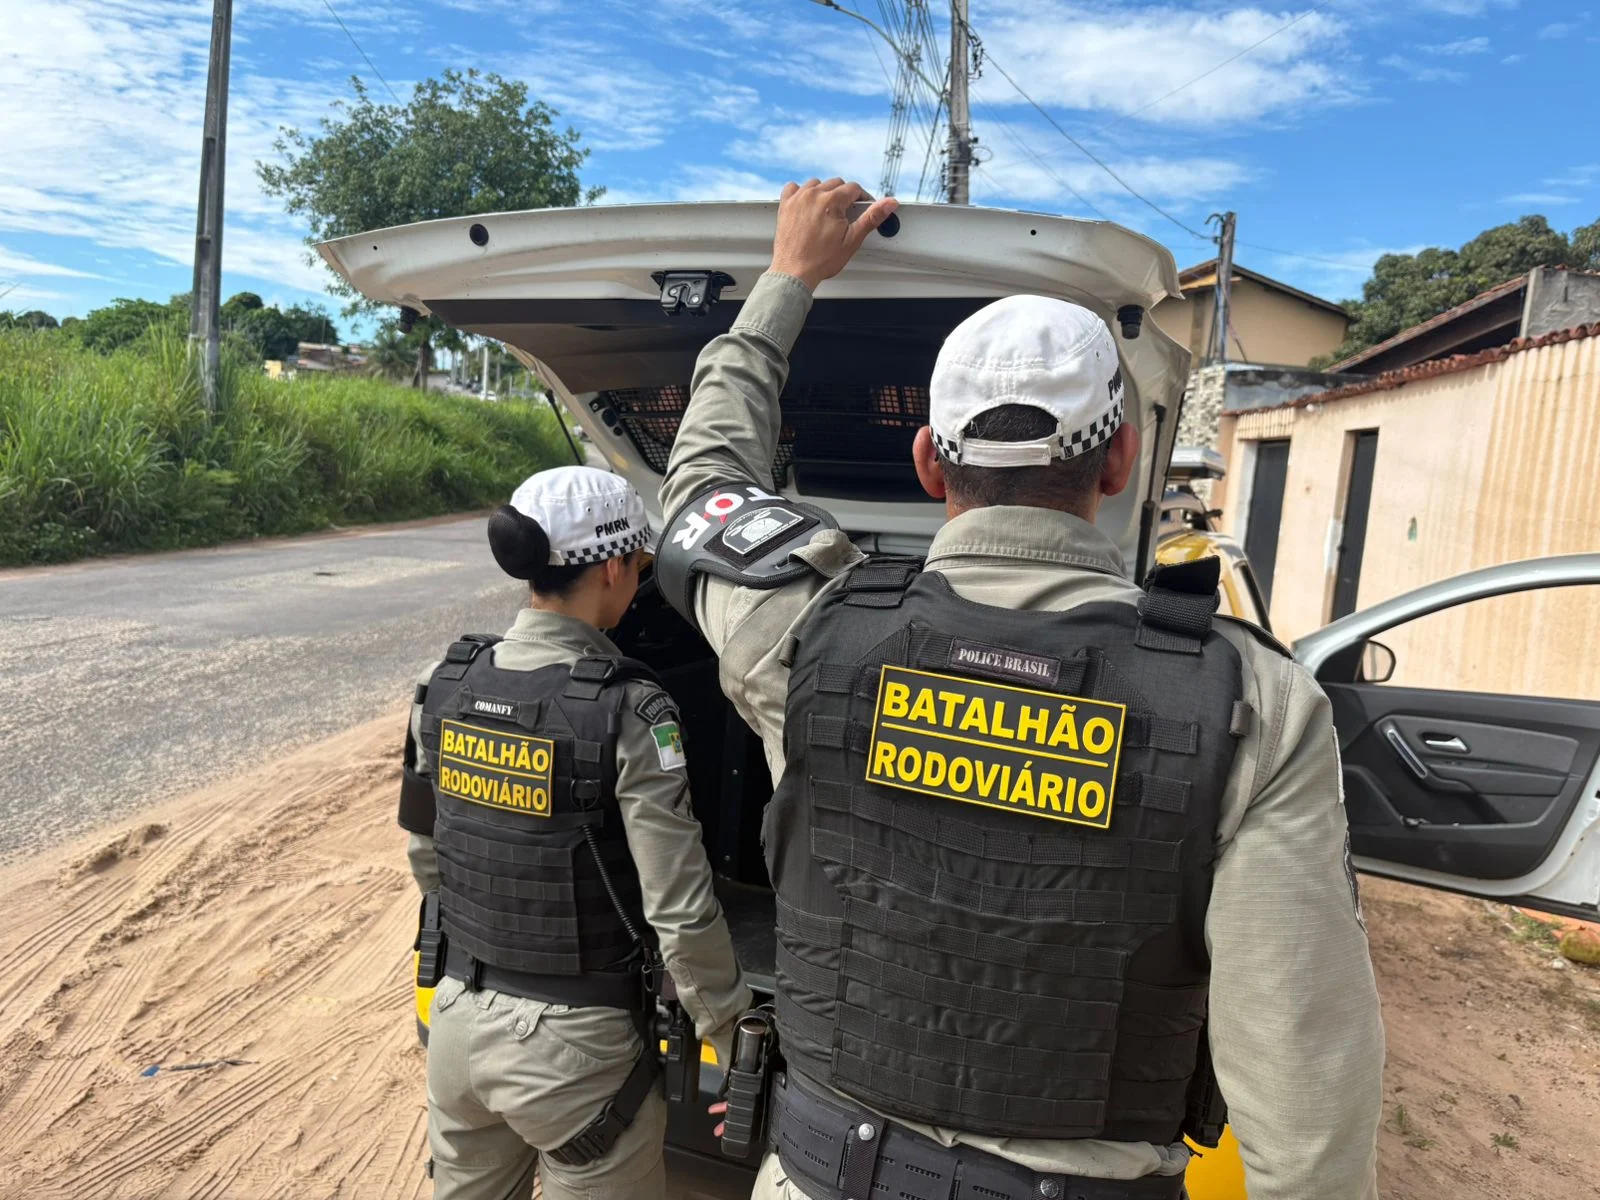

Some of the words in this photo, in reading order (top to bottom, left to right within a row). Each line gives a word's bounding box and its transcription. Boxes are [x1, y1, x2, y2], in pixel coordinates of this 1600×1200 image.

[595, 517, 630, 539] PMRN
[958, 648, 1002, 668] POLICE
[1003, 656, 1050, 678] BRASIL
[882, 681, 1115, 755] BATALHÃO
[443, 728, 549, 772] BATALHÃO
[440, 766, 548, 812] RODOVIÁRIO
[873, 740, 1106, 818] RODOVIÁRIO
